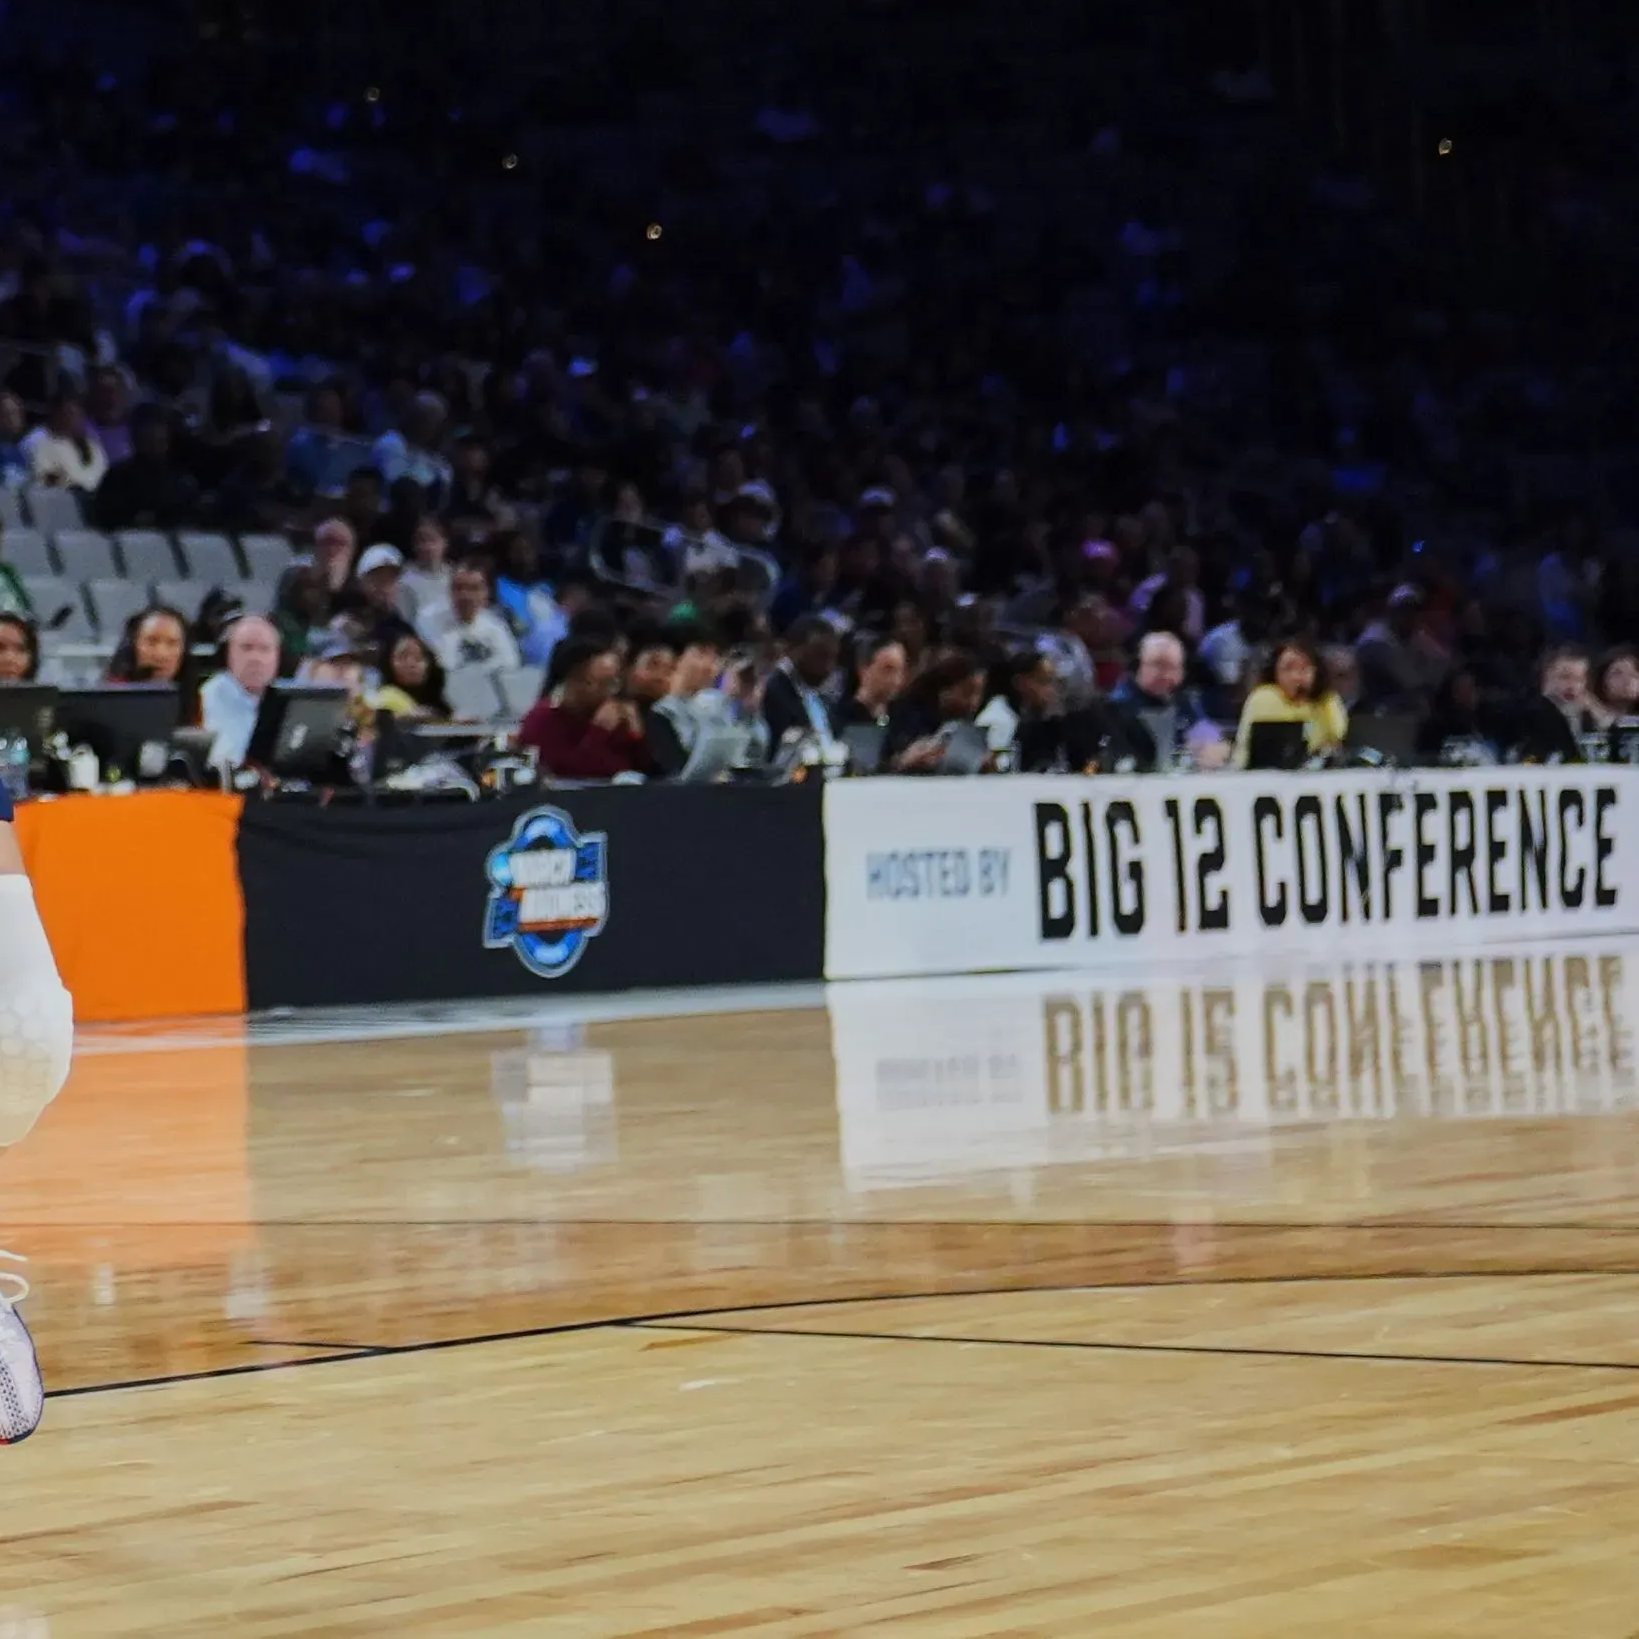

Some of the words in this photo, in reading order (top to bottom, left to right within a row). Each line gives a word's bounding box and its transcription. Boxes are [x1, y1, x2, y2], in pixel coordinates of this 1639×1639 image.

[865, 849, 971, 902] HOSTED
[975, 847, 1012, 896] BY
[1034, 800, 1145, 940] BIG
[1164, 796, 1229, 933] 12
[1252, 787, 1619, 928] CONFERENCE
